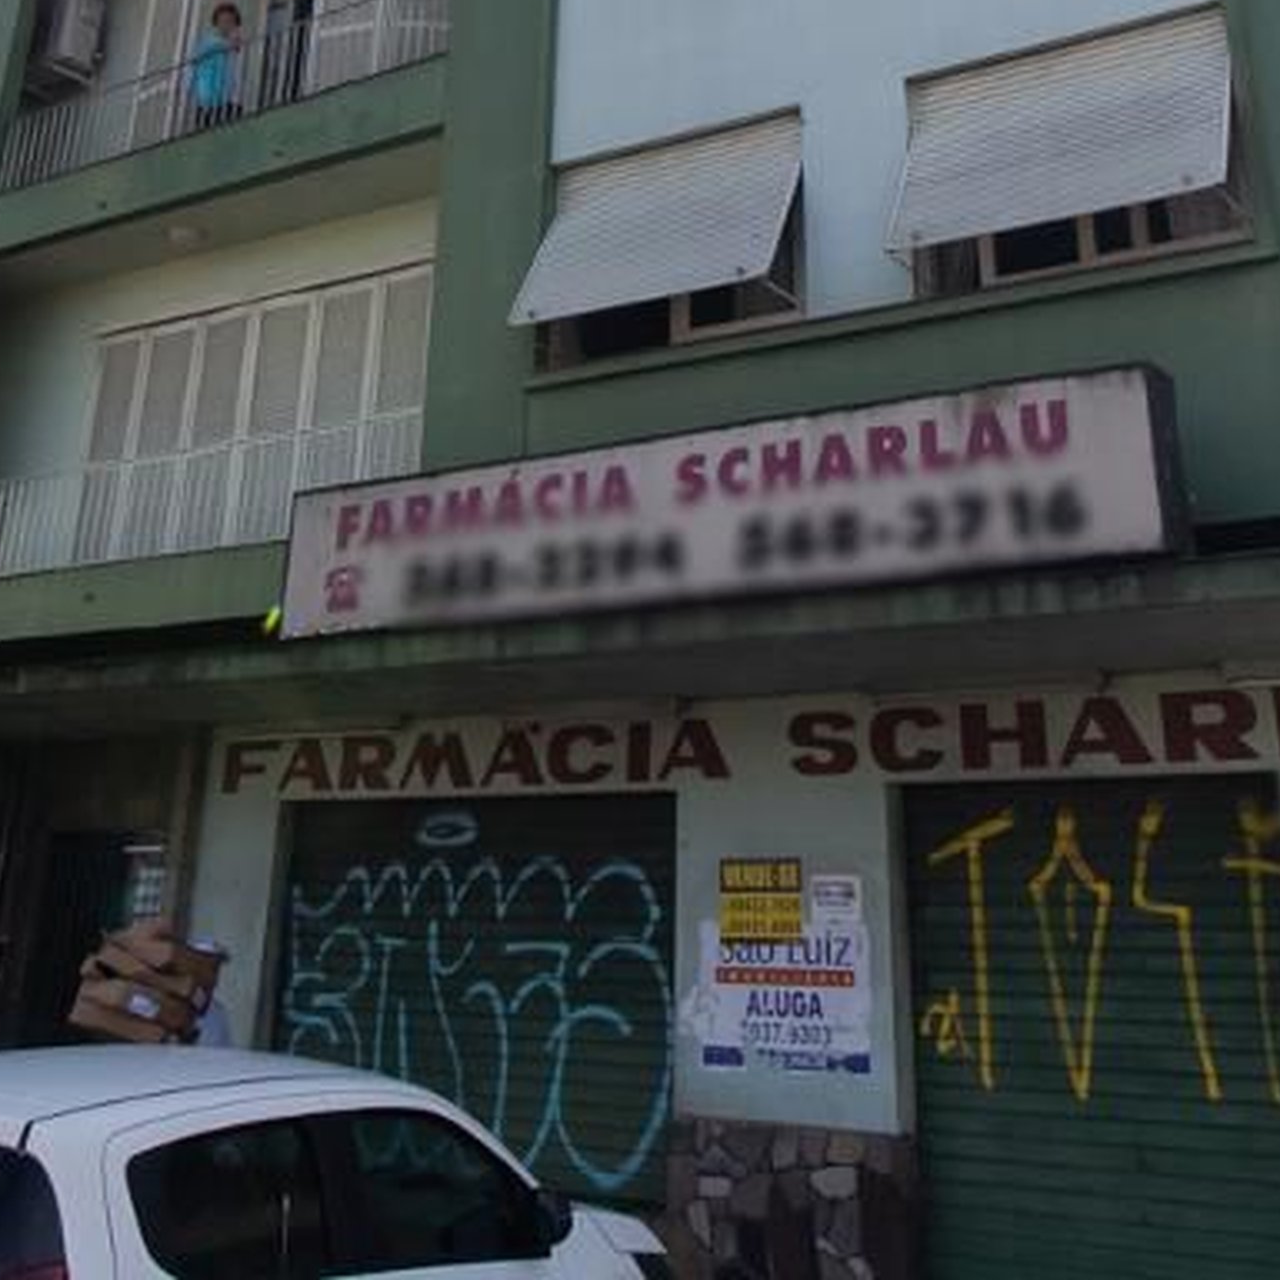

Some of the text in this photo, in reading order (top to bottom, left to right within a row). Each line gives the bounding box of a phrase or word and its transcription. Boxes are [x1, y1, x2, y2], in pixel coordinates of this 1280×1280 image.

[336, 398, 1070, 548] FARMÁCIA SCHARLAU
[745, 991, 825, 1019] ALUGA
